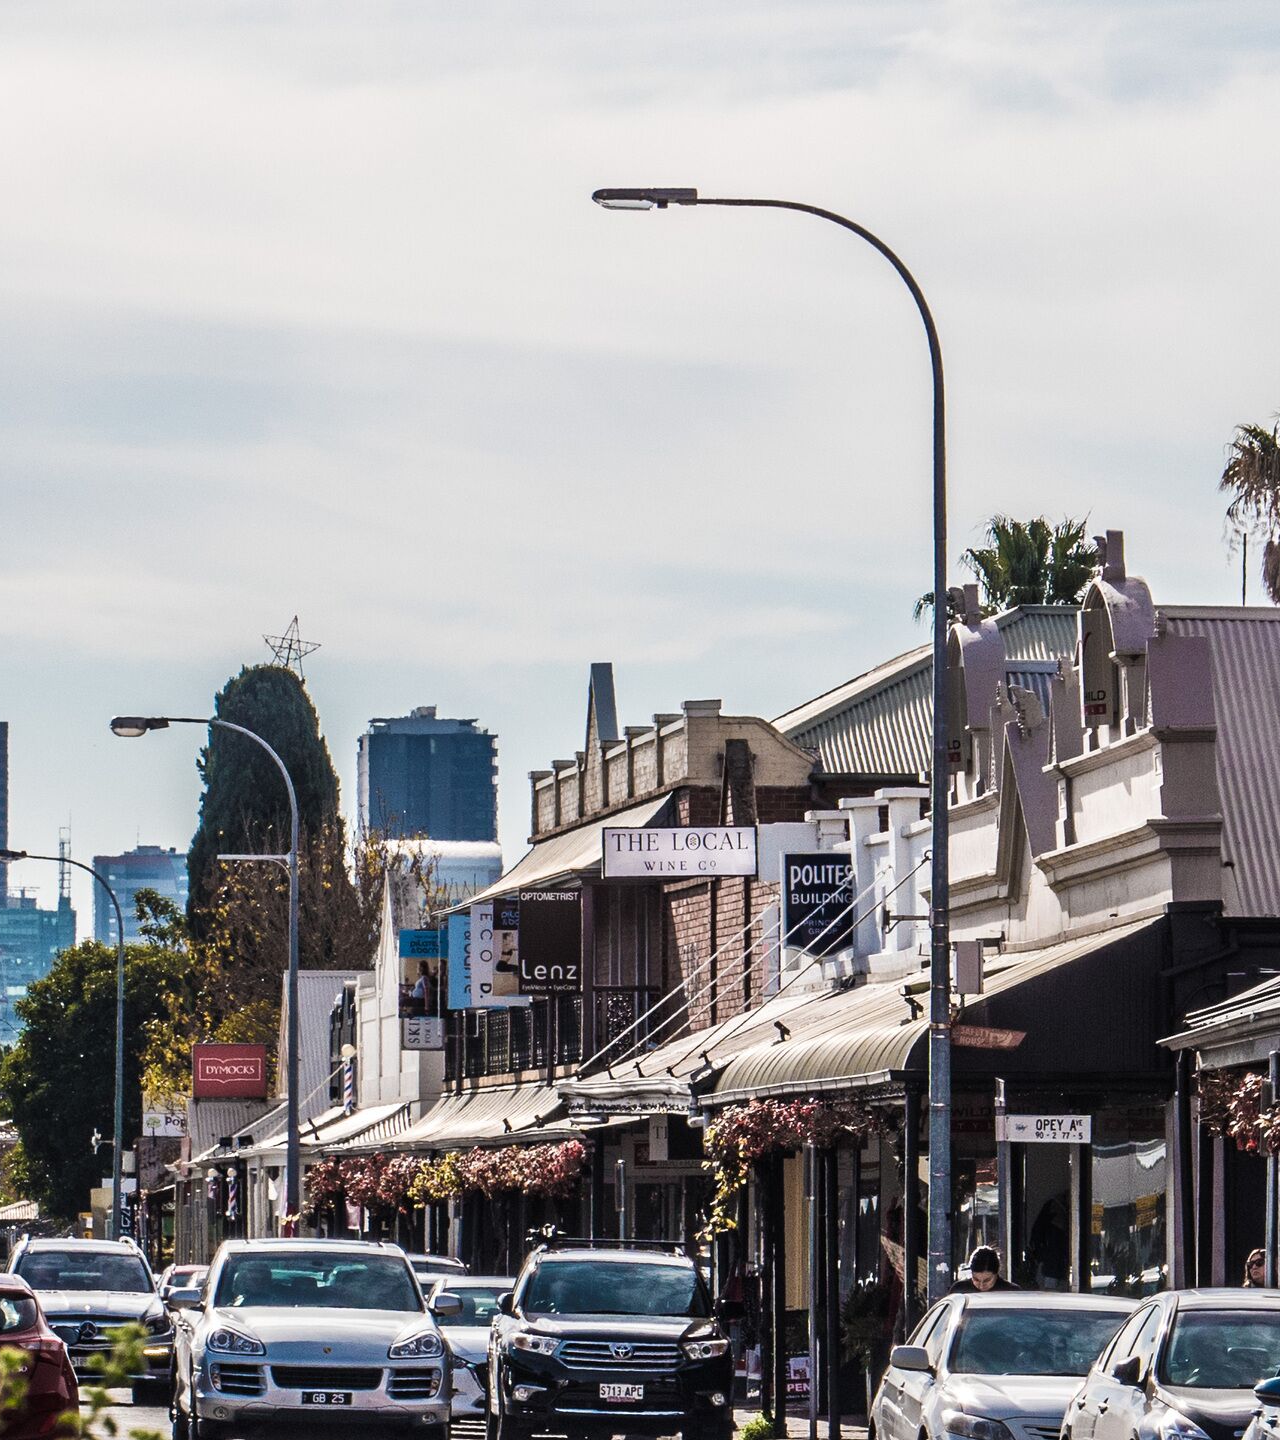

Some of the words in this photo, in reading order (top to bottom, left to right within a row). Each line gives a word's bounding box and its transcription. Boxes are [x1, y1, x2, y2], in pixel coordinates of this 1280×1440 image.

[611, 832, 660, 852] THE
[671, 831, 749, 851] LOCAL
[643, 860, 688, 871] WINE
[521, 891, 579, 901] OPTOMETRIST
[791, 893, 853, 905] BUILDING
[521, 959, 577, 980] Lenz
[205, 1064, 255, 1076] DYMOCKS
[1035, 1119, 1064, 1131] OPEY
[312, 1393, 326, 1403] GB
[331, 1393, 345, 1404] 25
